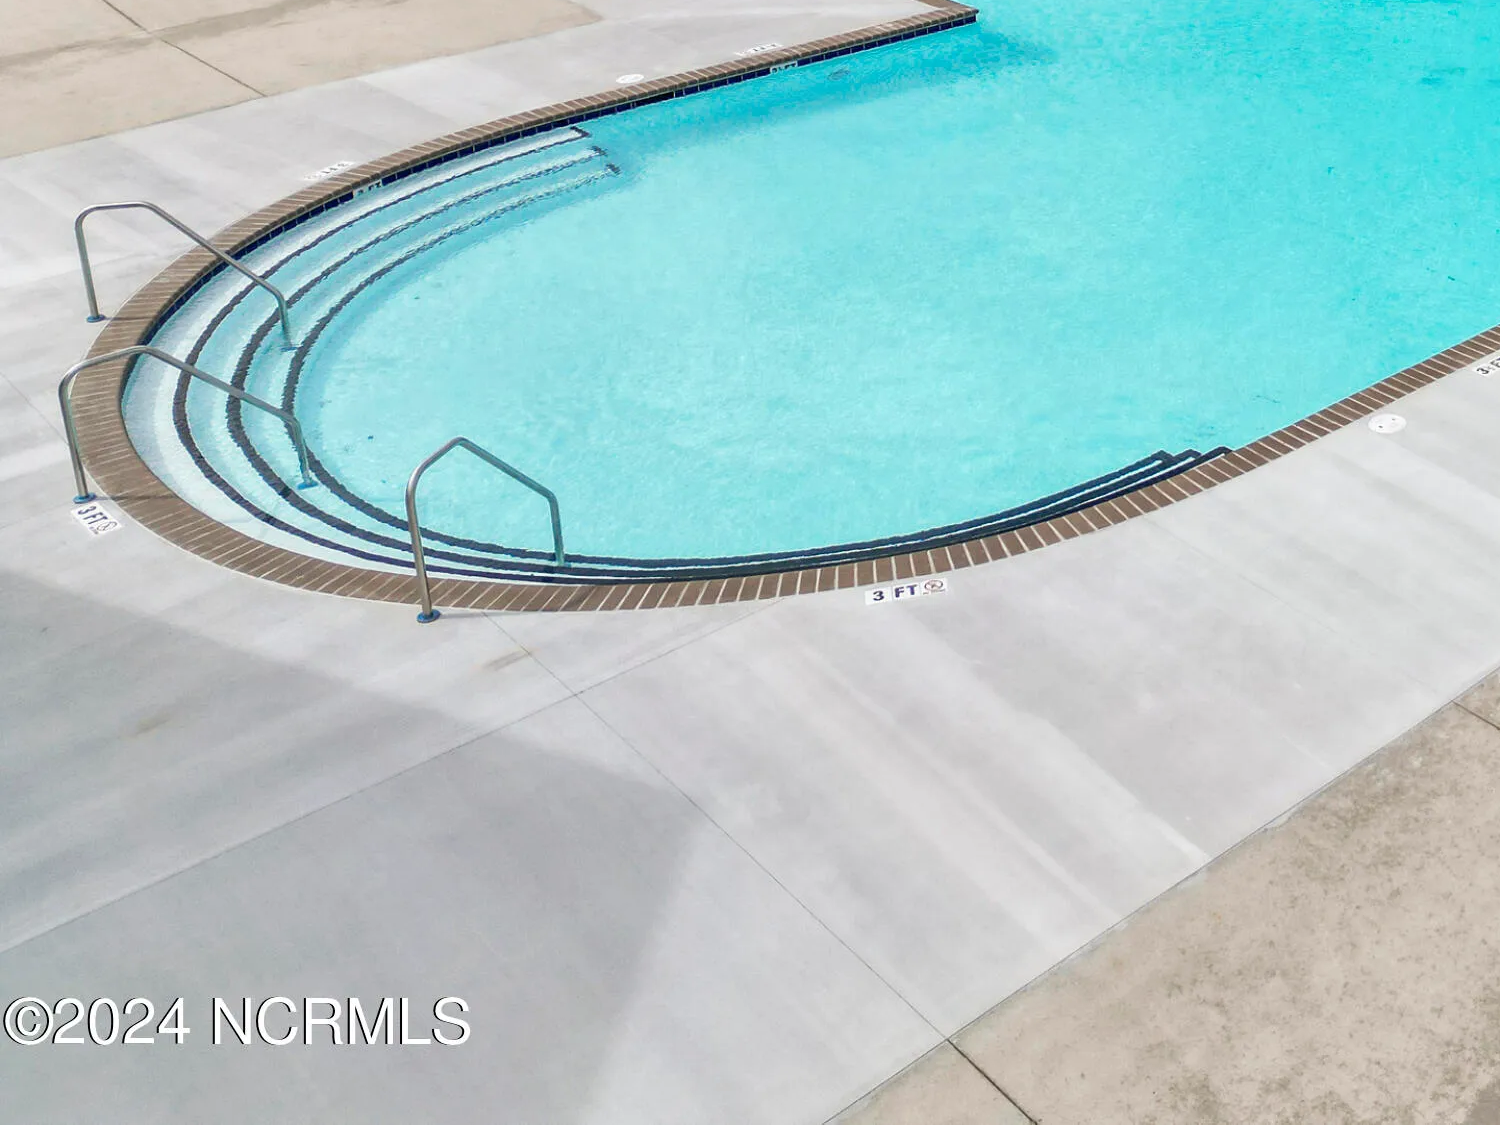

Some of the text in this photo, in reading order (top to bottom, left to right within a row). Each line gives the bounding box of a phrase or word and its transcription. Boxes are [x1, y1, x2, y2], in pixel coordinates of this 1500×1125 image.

[77, 505, 108, 525] 3 FT
[873, 590, 885, 601] 3
[894, 584, 918, 598] FT
